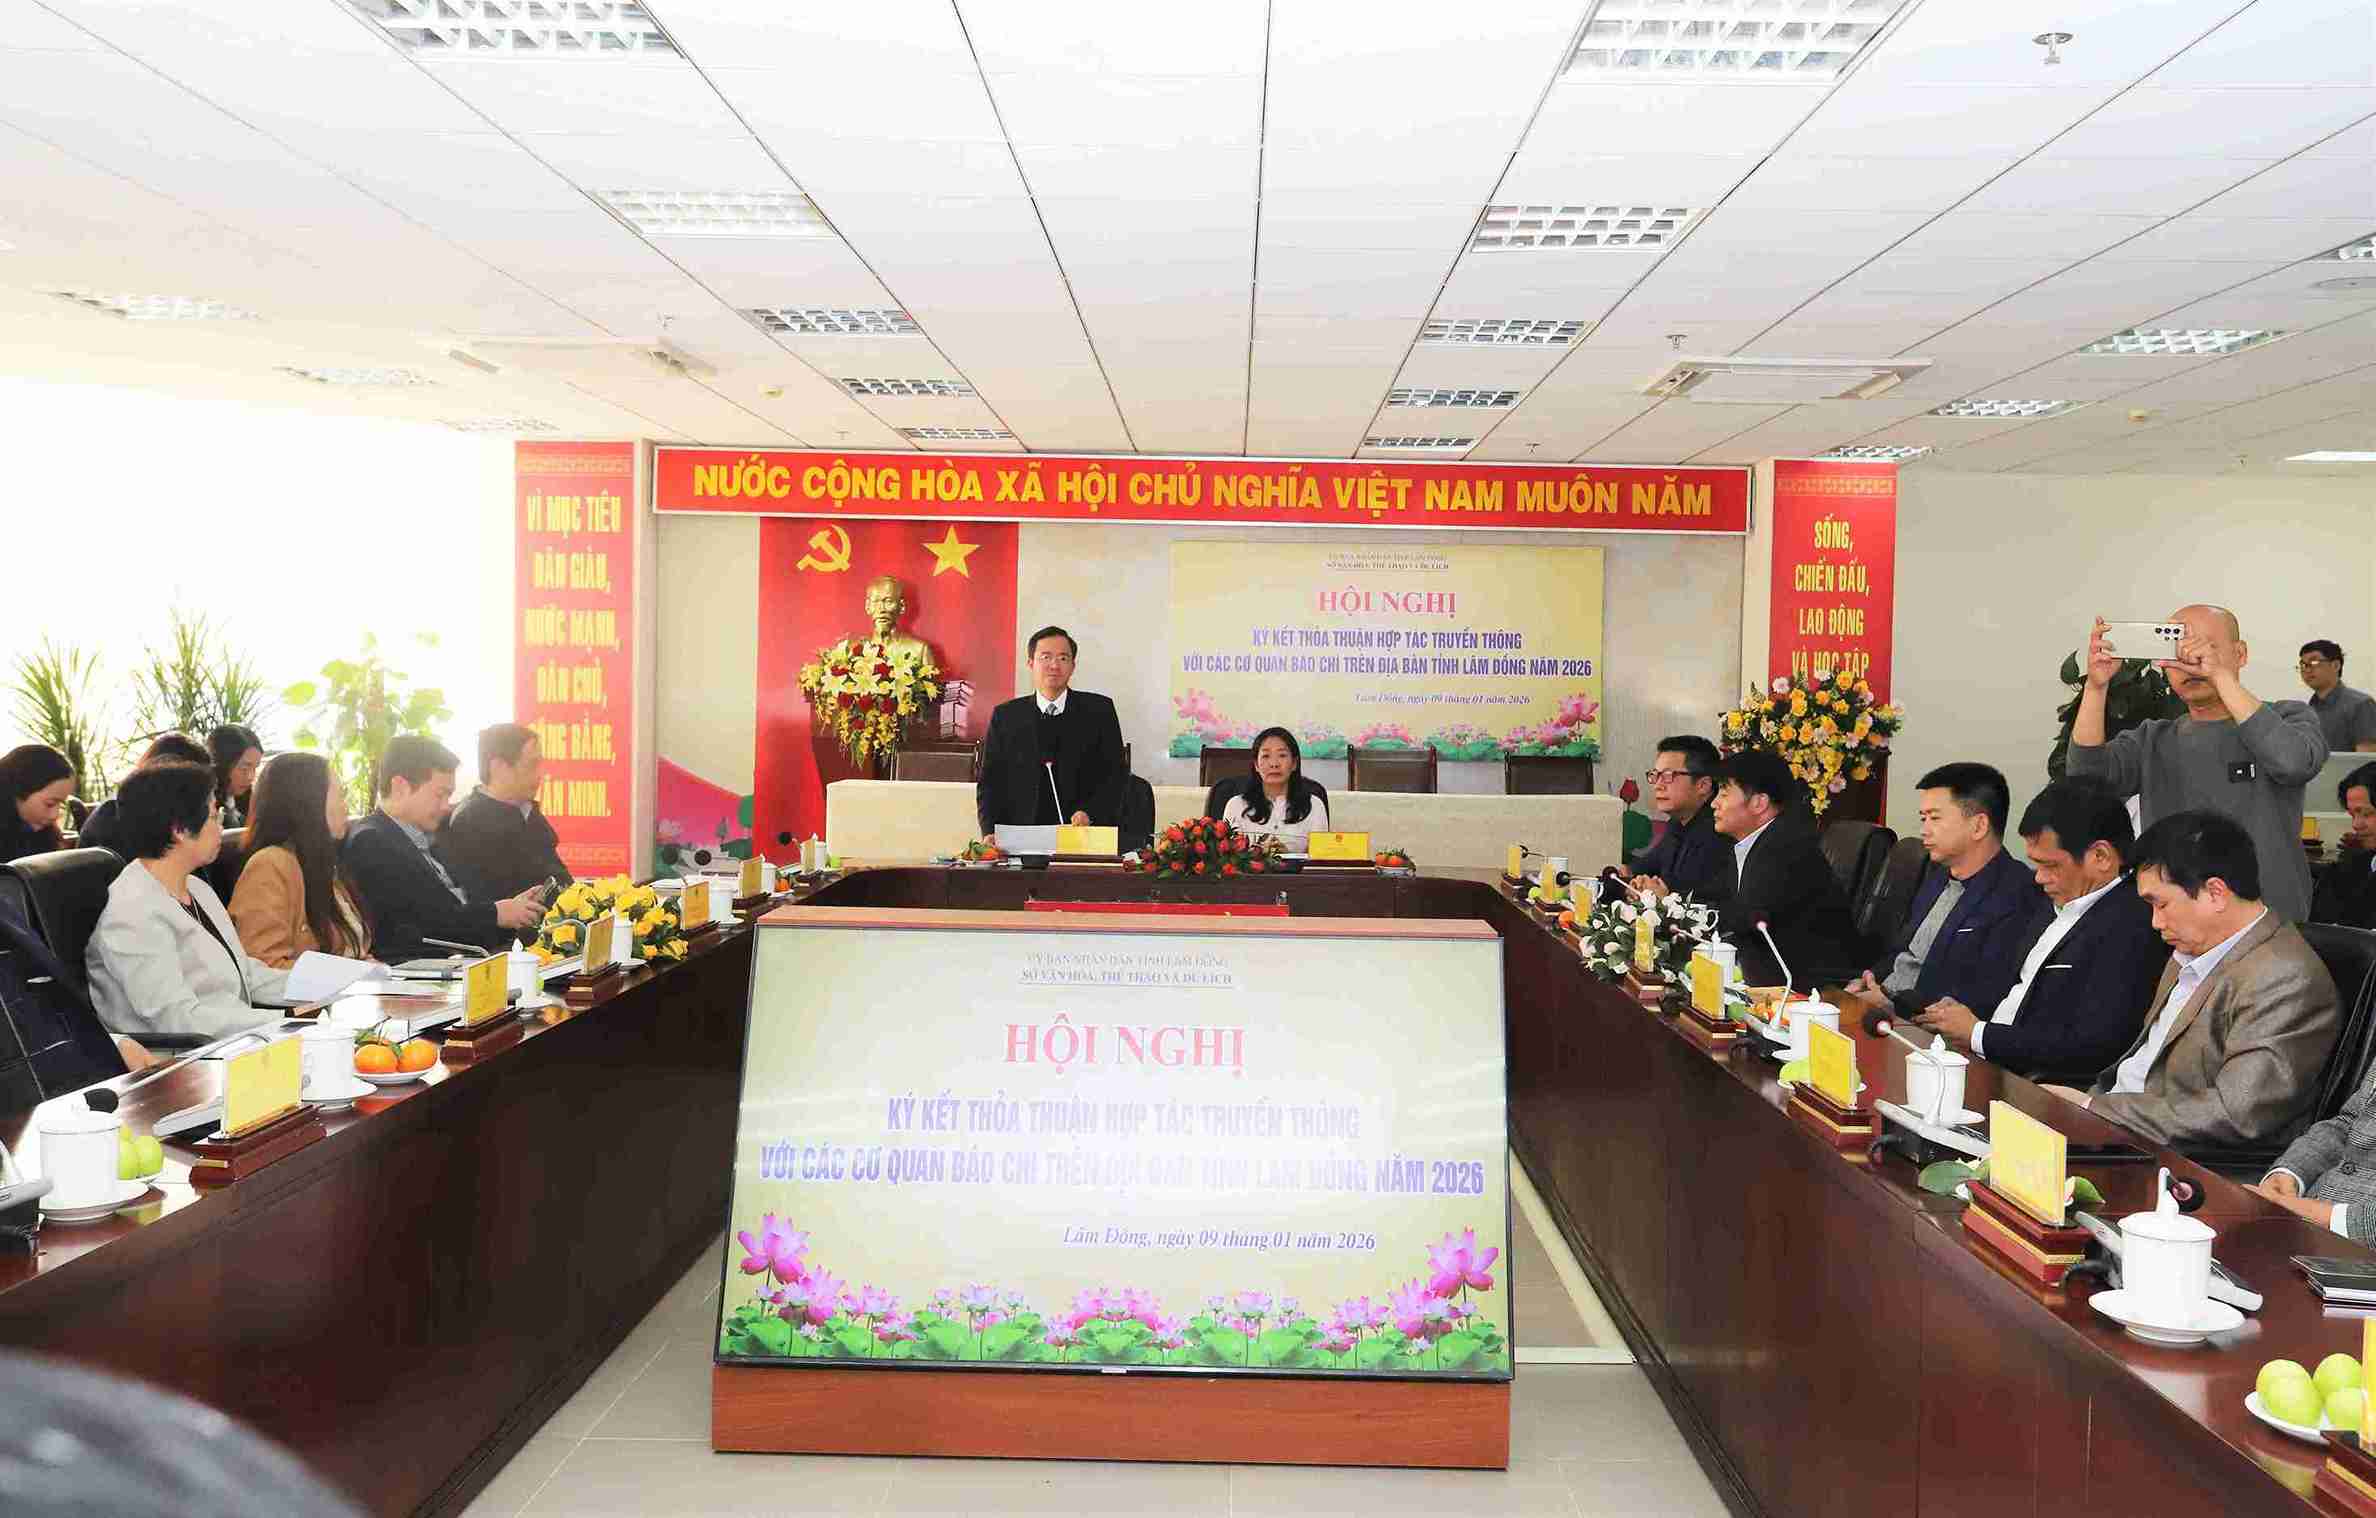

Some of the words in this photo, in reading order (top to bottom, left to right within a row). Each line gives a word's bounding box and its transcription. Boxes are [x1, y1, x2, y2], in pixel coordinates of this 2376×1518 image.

[694, 454, 792, 498] NƯỚC
[802, 458, 901, 508] CỘNG
[911, 459, 984, 502] HÒA
[994, 461, 1046, 504] XÃ
[1057, 463, 1117, 511] HỘI
[1129, 461, 1202, 507] CHỦ
[1213, 466, 1323, 510] NGHĨA
[1332, 470, 1413, 519] VIỆT
[1424, 478, 1505, 513] NAM
[1516, 473, 1619, 515] MUÔN
[1631, 475, 1712, 517] NĂM
[527, 487, 542, 532] VÌ
[1814, 513, 1854, 553] SỐNG,
[1795, 555, 1834, 593] CHIẾN
[1838, 556, 1871, 597] ĐẤU,
[1319, 585, 1376, 617] HỘI
[1382, 591, 1457, 619] NGHỊ
[1799, 608, 1824, 636] LAO
[1828, 602, 1865, 642] ĐỘNG
[1272, 625, 1295, 647] KẾT
[1333, 628, 1374, 651] THUẬN
[1377, 629, 1401, 651] HỢP
[1482, 629, 1522, 650] THÔNG
[1183, 651, 1203, 673] VỚI
[1206, 652, 1231, 673] CÁC
[1234, 654, 1251, 673] CƠ
[1255, 655, 1287, 674] QUAN
[1344, 653, 1375, 674] TRÊN
[1378, 655, 1399, 677] ĐỊA
[1402, 653, 1428, 674] BÀN
[1463, 655, 1489, 675] LÂM
[1529, 656, 1559, 676] NĂM
[1562, 659, 1592, 677] 2026
[1003, 1012, 1100, 1075] HỘI
[1113, 1024, 1247, 1078] NGHỊ
[887, 1089, 917, 1131] KÝ
[920, 1089, 962, 1132] KẾT
[967, 1089, 1022, 1134] THỎA
[1028, 1095, 1099, 1142] THUẬN
[761, 1140, 798, 1179] VỚI
[801, 1141, 846, 1180] CÁC
[851, 1146, 881, 1181] CƠ
[887, 1147, 945, 1185] QUAN
[950, 1145, 995, 1184] BÁO
[1375, 1153, 1425, 1193] NĂM
[1431, 1160, 1484, 1194] 2026
[1063, 1226, 1099, 1245] Lâm
[1157, 1229, 1194, 1250] ngày
[1199, 1230, 1219, 1246] 09
[1222, 1230, 1269, 1252] tháng
[1273, 1231, 1292, 1248] 01
[1296, 1231, 1333, 1249] năm
[1336, 1233, 1376, 1250] 2026
